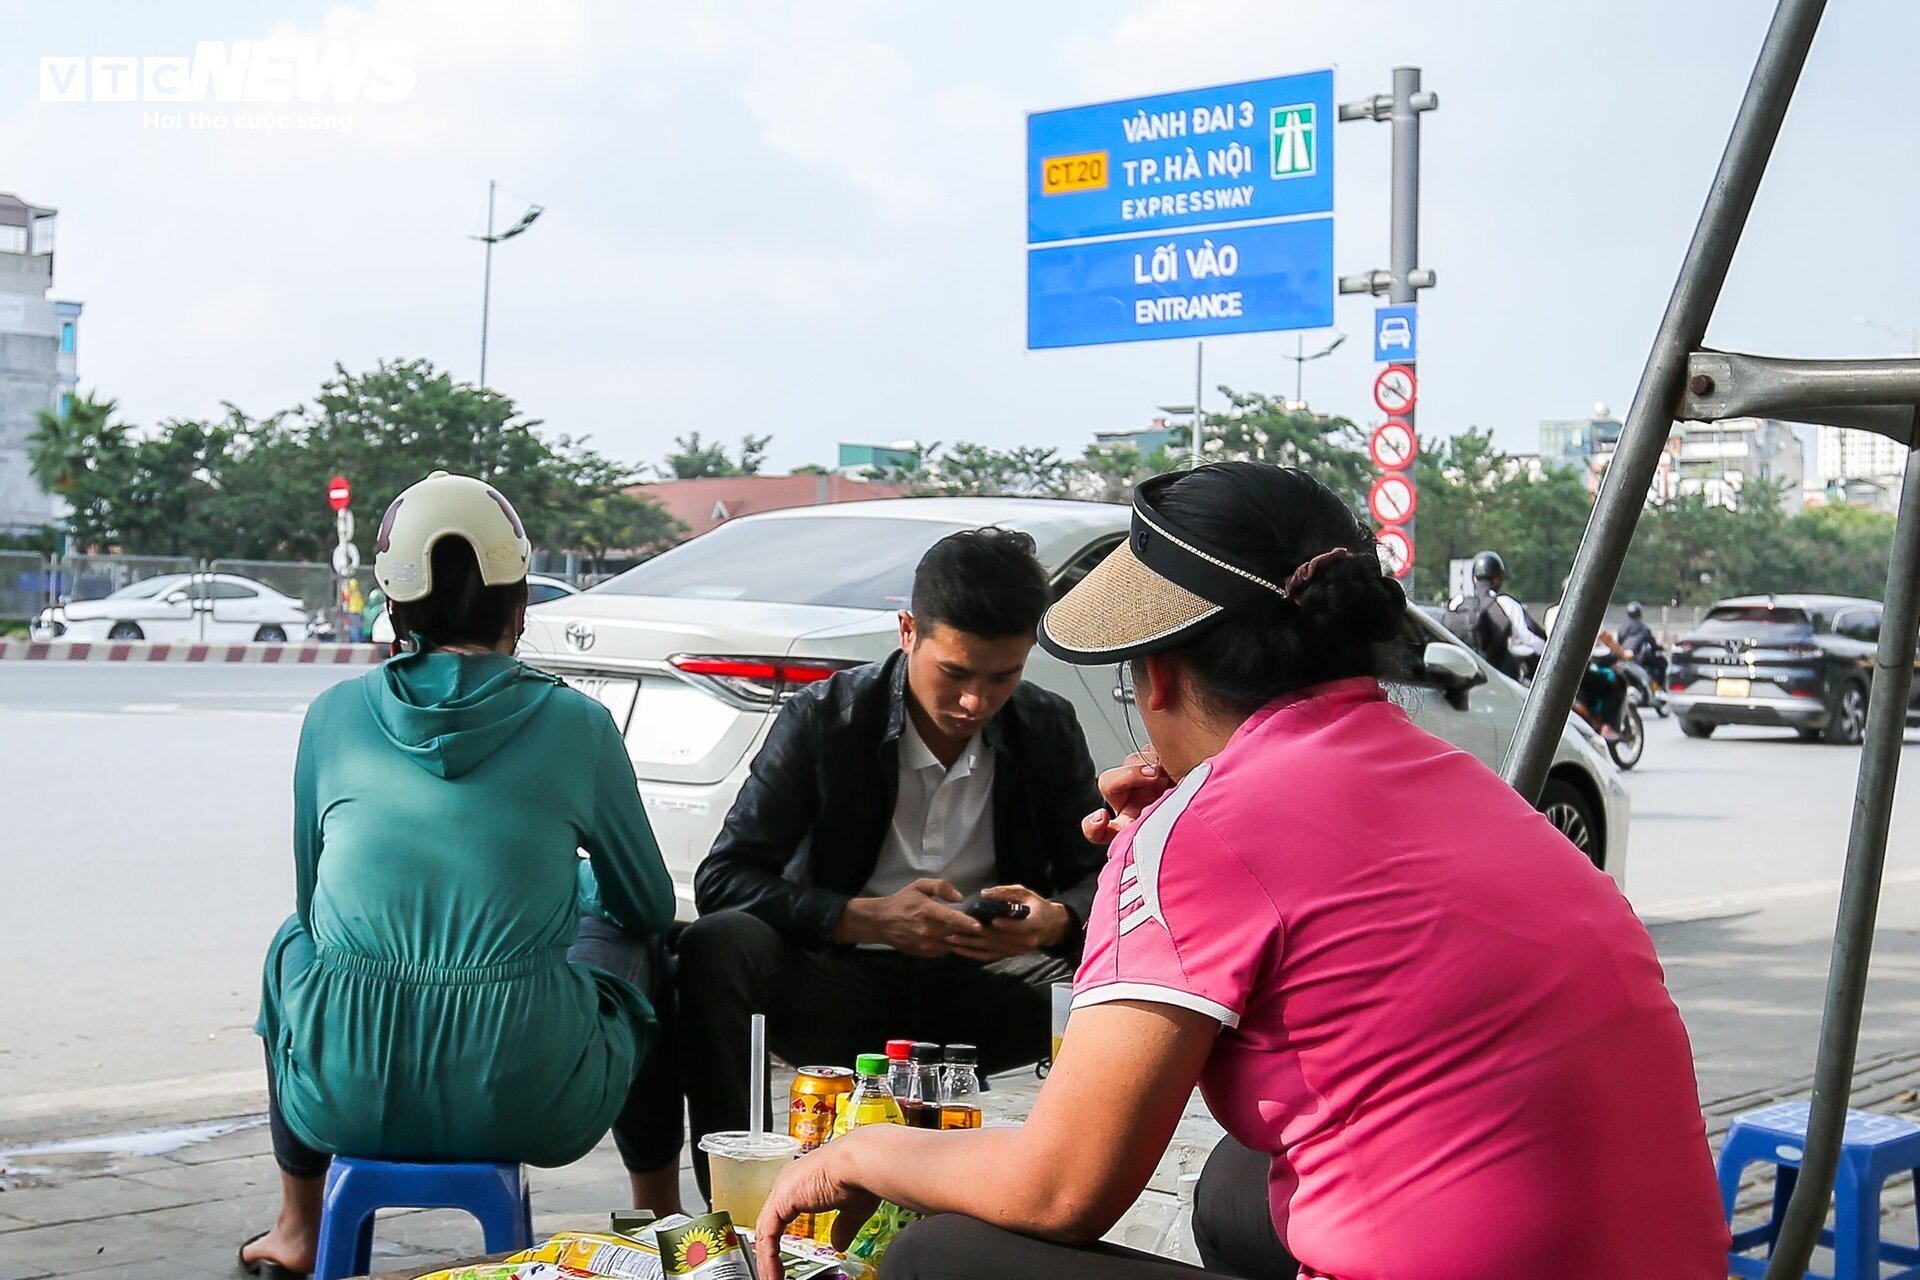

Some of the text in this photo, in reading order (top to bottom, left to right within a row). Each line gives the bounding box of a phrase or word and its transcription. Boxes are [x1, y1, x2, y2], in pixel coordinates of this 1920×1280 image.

[1122, 100, 1255, 143] VÀNH ĐAI 3
[1046, 159, 1102, 186] CT.20
[1207, 141, 1253, 179] NỘI
[1121, 184, 1255, 221] EXPRESSWAY
[1134, 238, 1239, 284] LỐI VÀO
[1135, 291, 1243, 325] ENTRANCE
